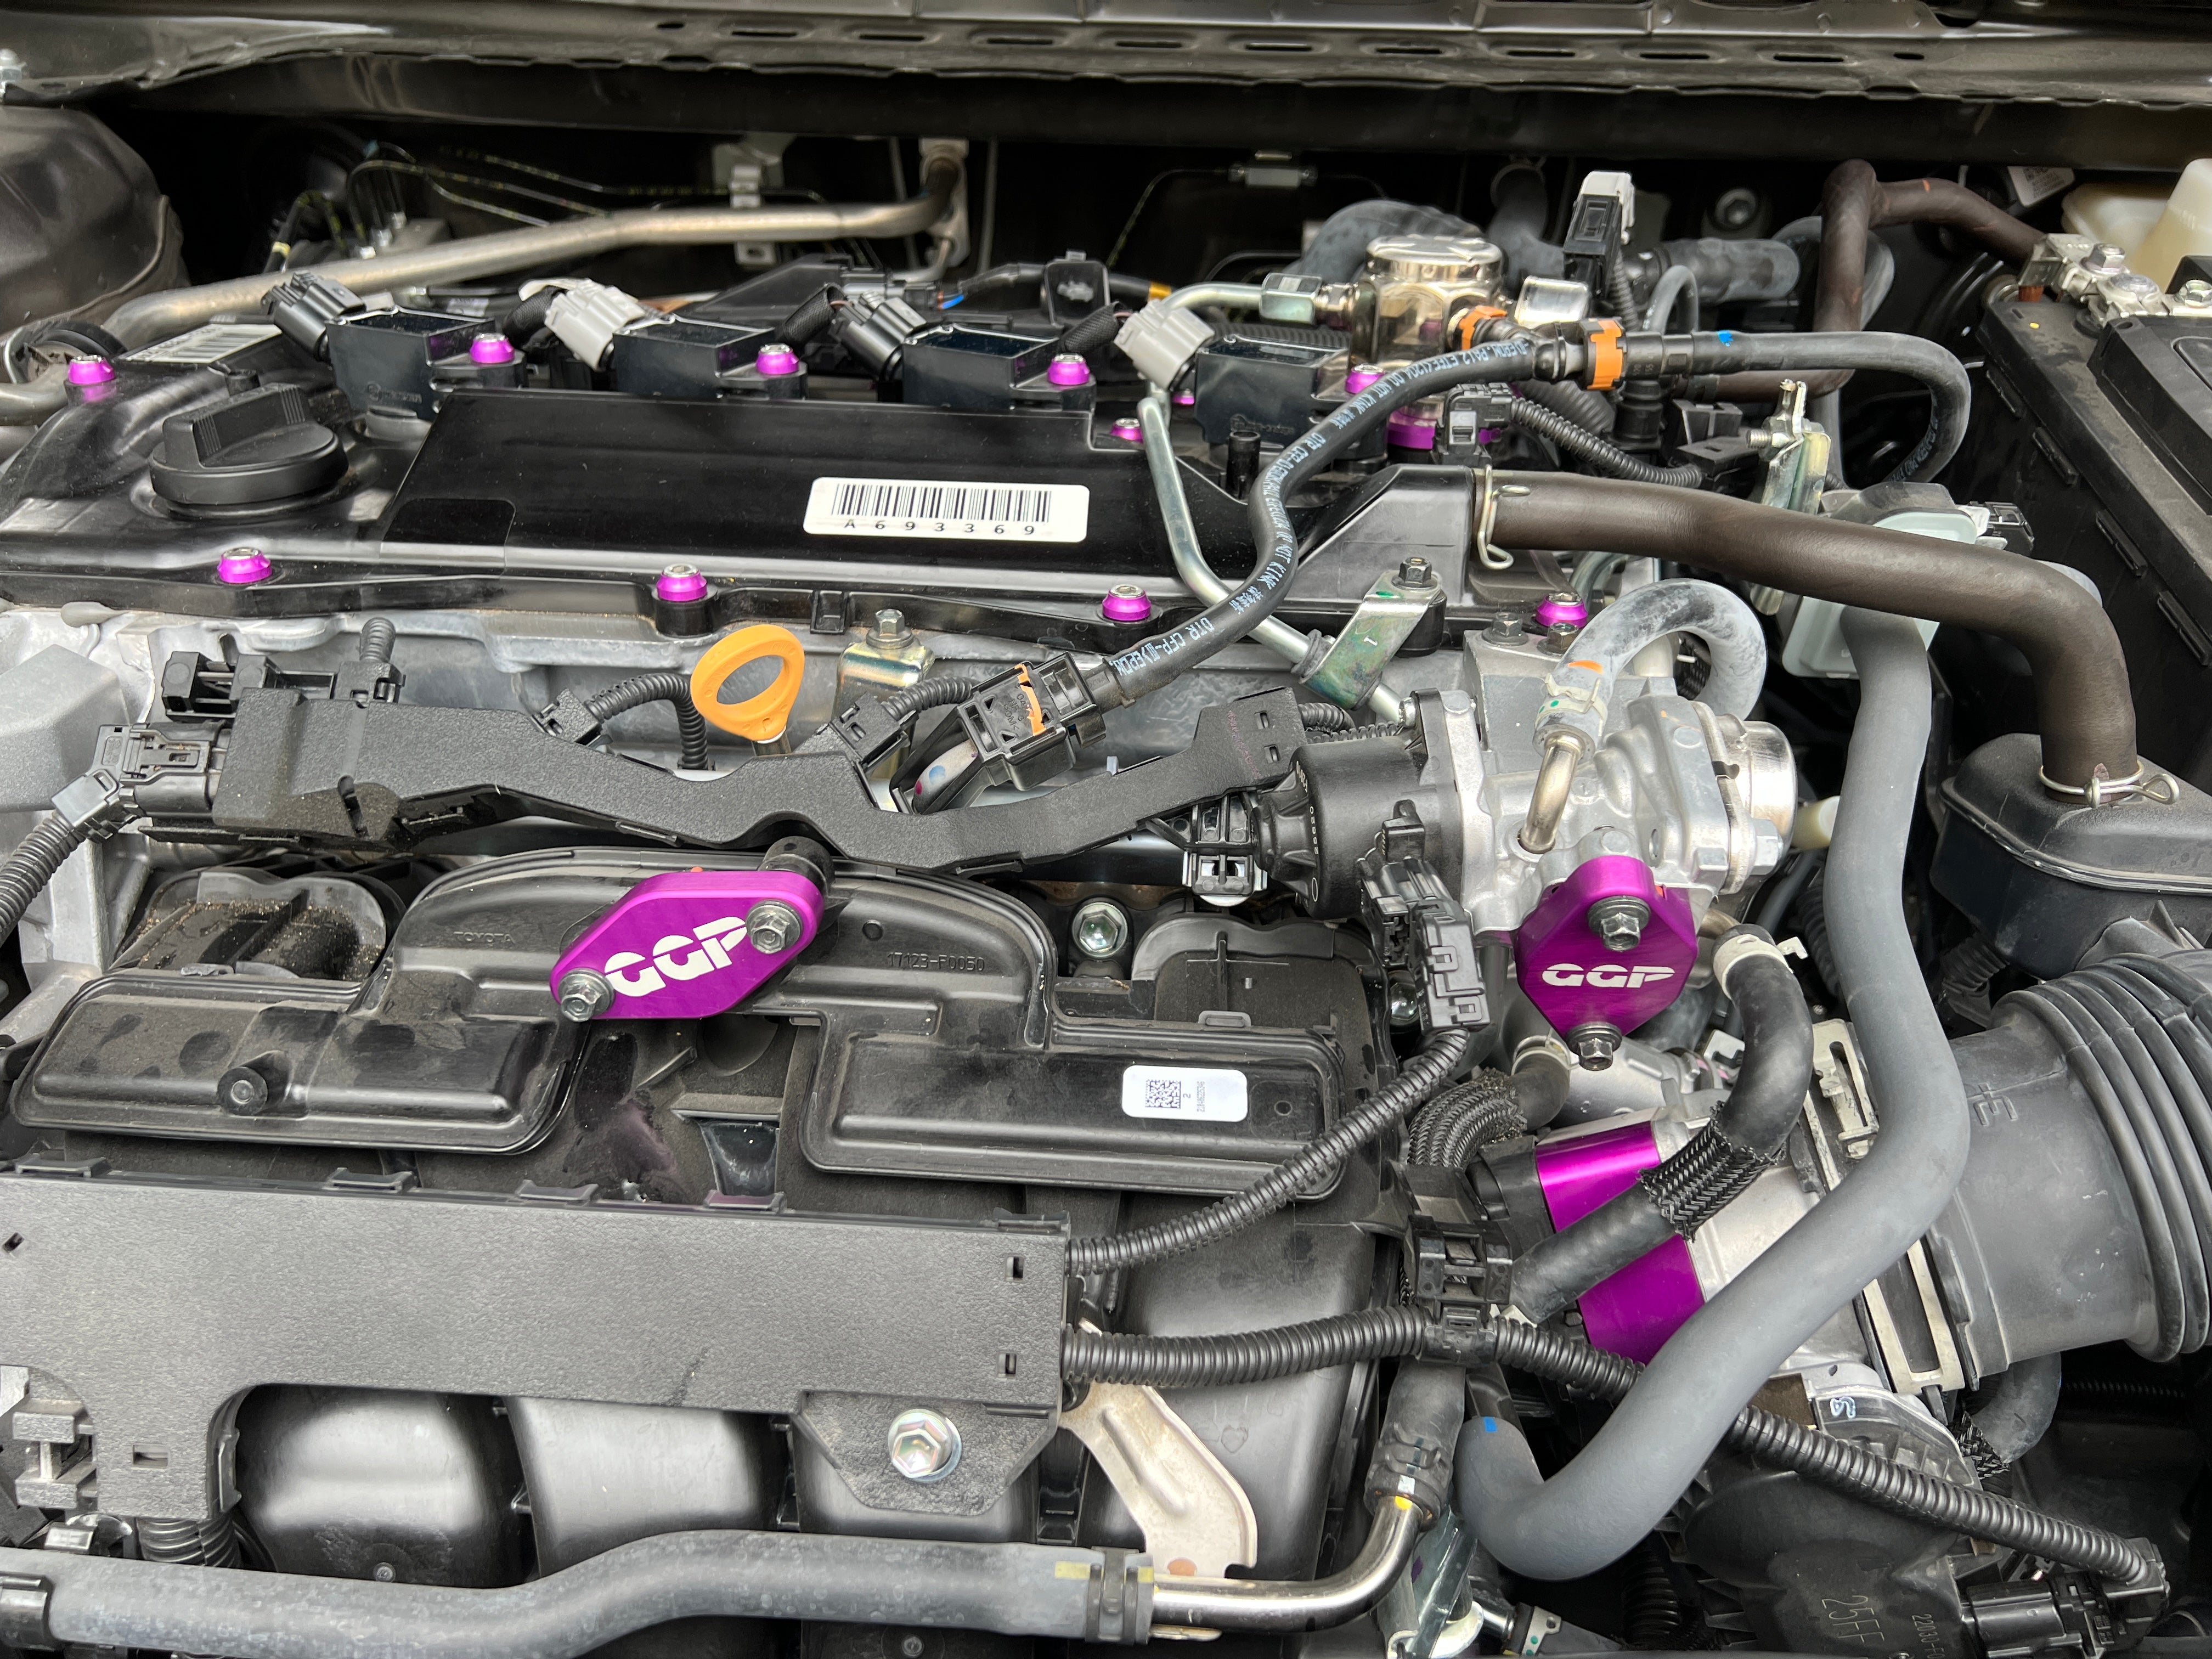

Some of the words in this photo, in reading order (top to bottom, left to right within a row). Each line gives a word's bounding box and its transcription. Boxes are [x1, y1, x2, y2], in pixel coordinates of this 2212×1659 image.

[844, 518, 1035, 535] A693369
[1257, 561, 1286, 590] KINK
[453, 930, 516, 944] TOYOTA
[886, 951, 985, 972] 17123-F0050
[1821, 1594, 1886, 1643] 25FF
